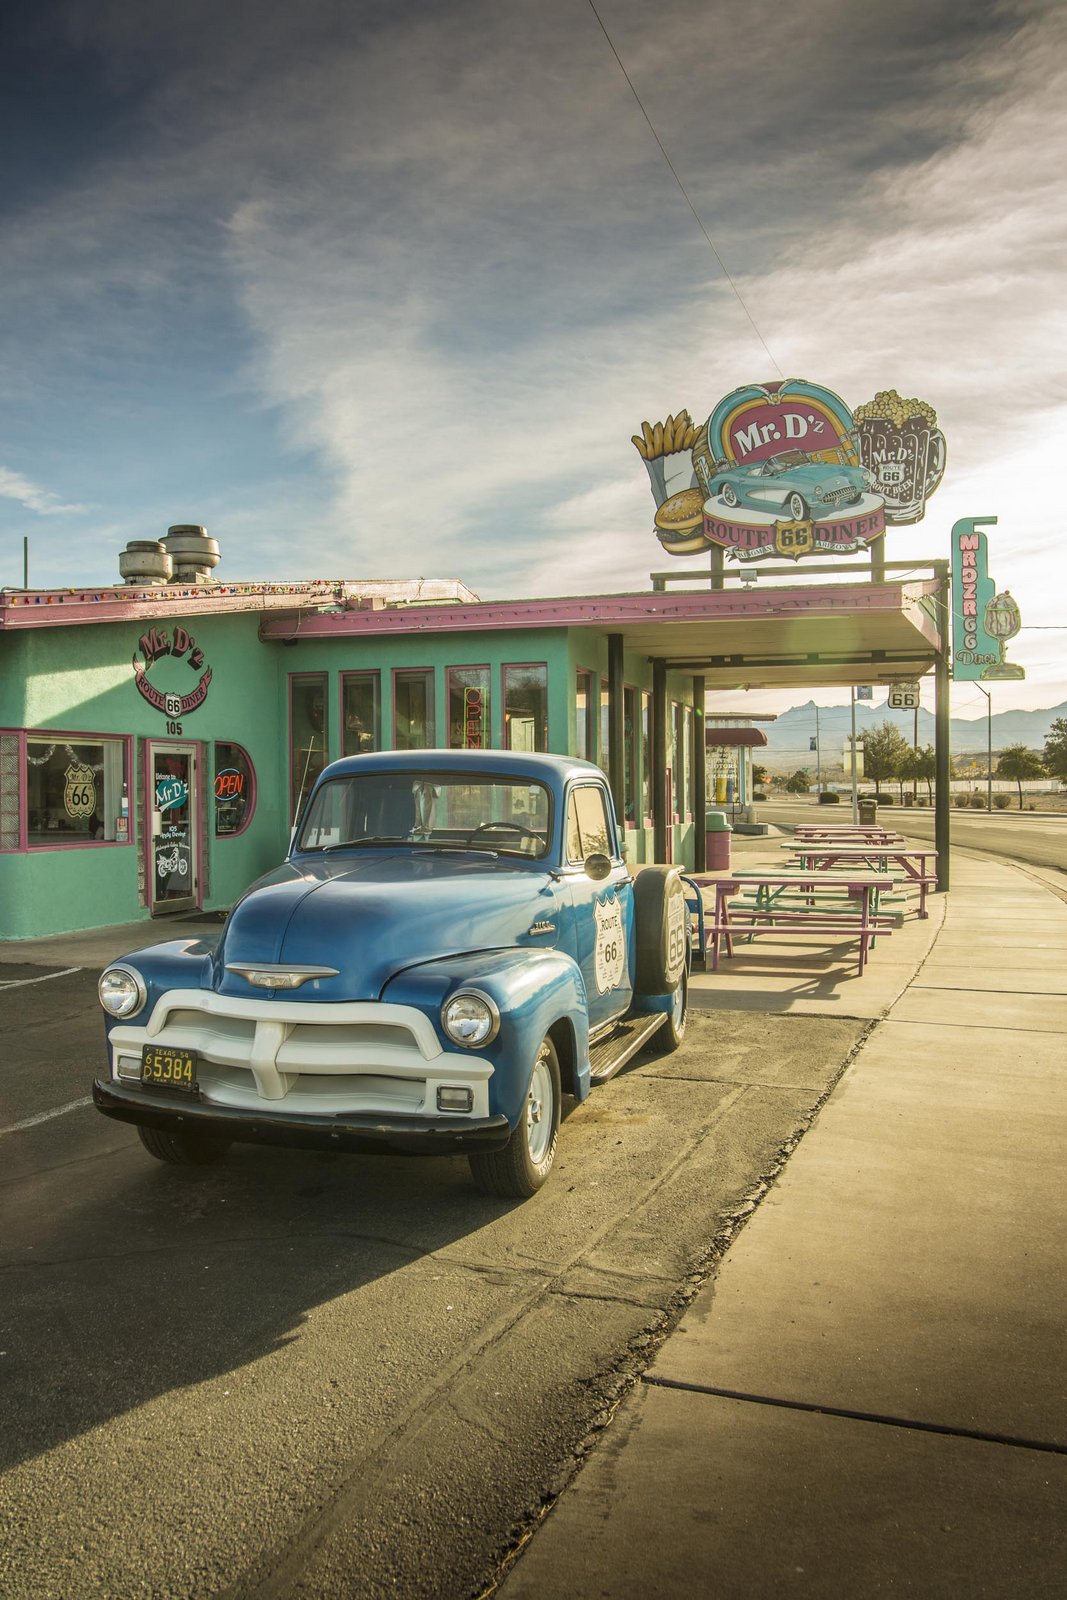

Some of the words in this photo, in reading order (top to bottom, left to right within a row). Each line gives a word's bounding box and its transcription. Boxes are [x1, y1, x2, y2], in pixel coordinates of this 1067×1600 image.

[733, 422, 781, 457] Mr.
[783, 413, 825, 439] D'z
[872, 448, 897, 465] Mr.
[896, 447, 915, 461] D'z
[883, 471, 900, 482] 66
[892, 479, 915, 495] BEER
[705, 518, 770, 548] ROUTE
[781, 527, 808, 547] 66
[815, 516, 879, 542] DINER
[816, 540, 854, 551] ARIZONA
[139, 626, 171, 661] Mr.
[139, 675, 165, 707] ROUTE
[166, 699, 181, 713] 66
[181, 686, 206, 710] DINER
[892, 693, 915, 706] 66
[166, 721, 183, 736] 105
[466, 688, 482, 750] OPEN
[72, 785, 90, 806] 66
[213, 774, 244, 796] OPEN
[601, 914, 619, 932] ROUTE
[604, 941, 618, 963] 66
[669, 924, 684, 963] 66
[155, 1048, 177, 1057] TEXAS
[153, 1056, 193, 1082] 5384
